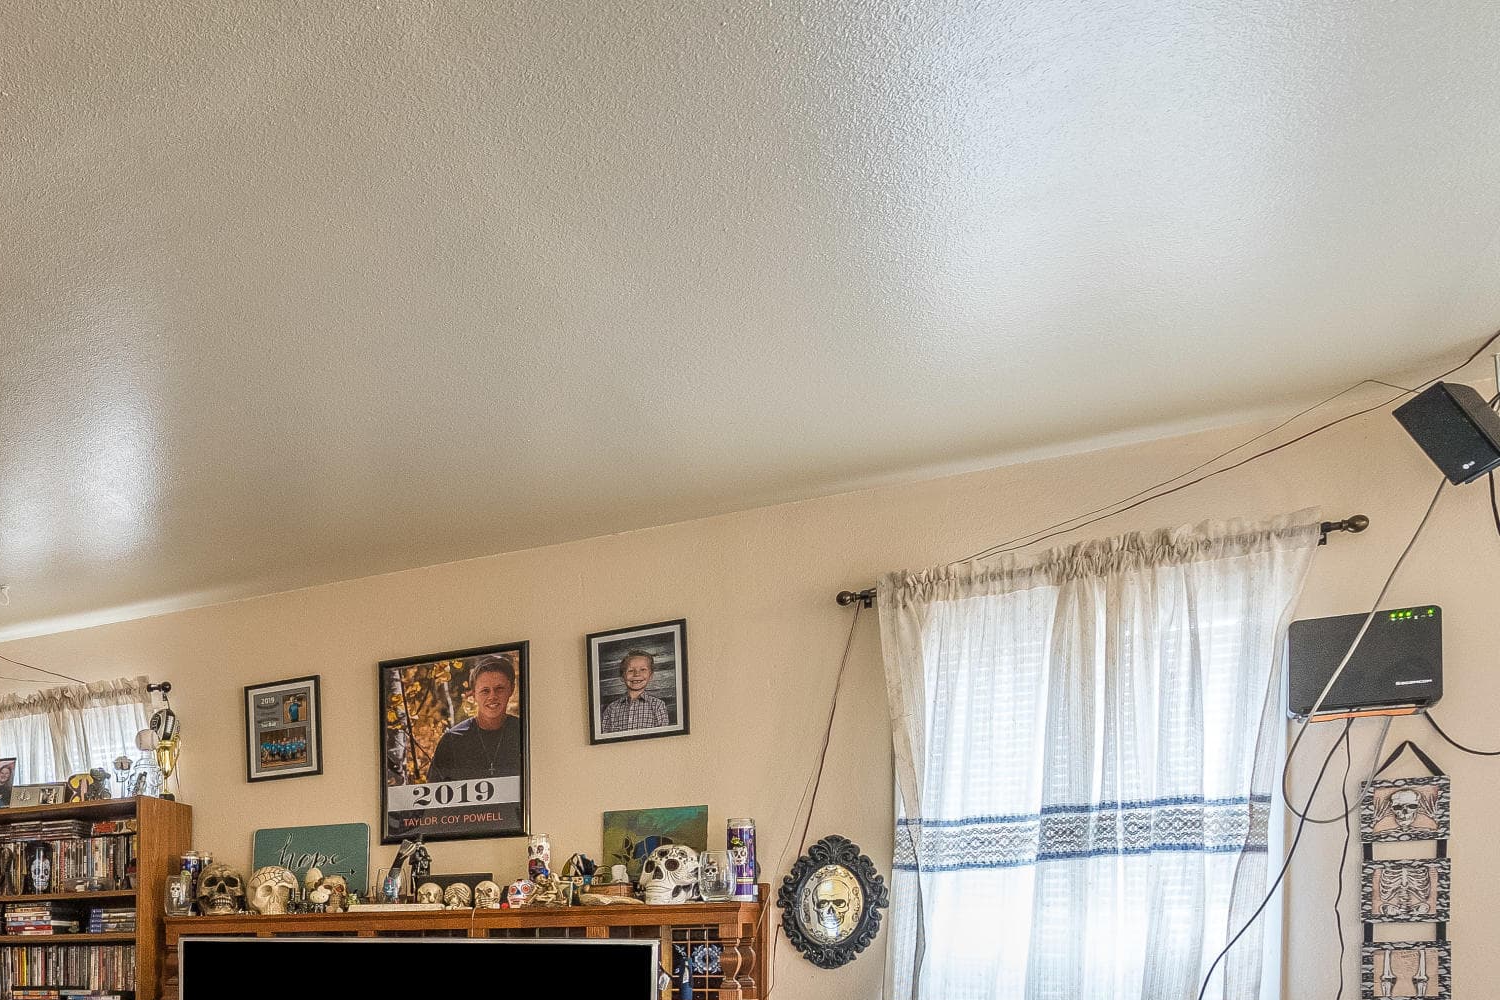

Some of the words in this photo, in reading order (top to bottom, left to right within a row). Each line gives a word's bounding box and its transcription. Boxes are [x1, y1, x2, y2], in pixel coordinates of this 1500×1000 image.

[412, 780, 495, 807] 2019
[403, 815, 438, 827] TAYLOR
[440, 815, 460, 824] COY
[463, 812, 504, 823] POWELL
[276, 832, 347, 872] hope
